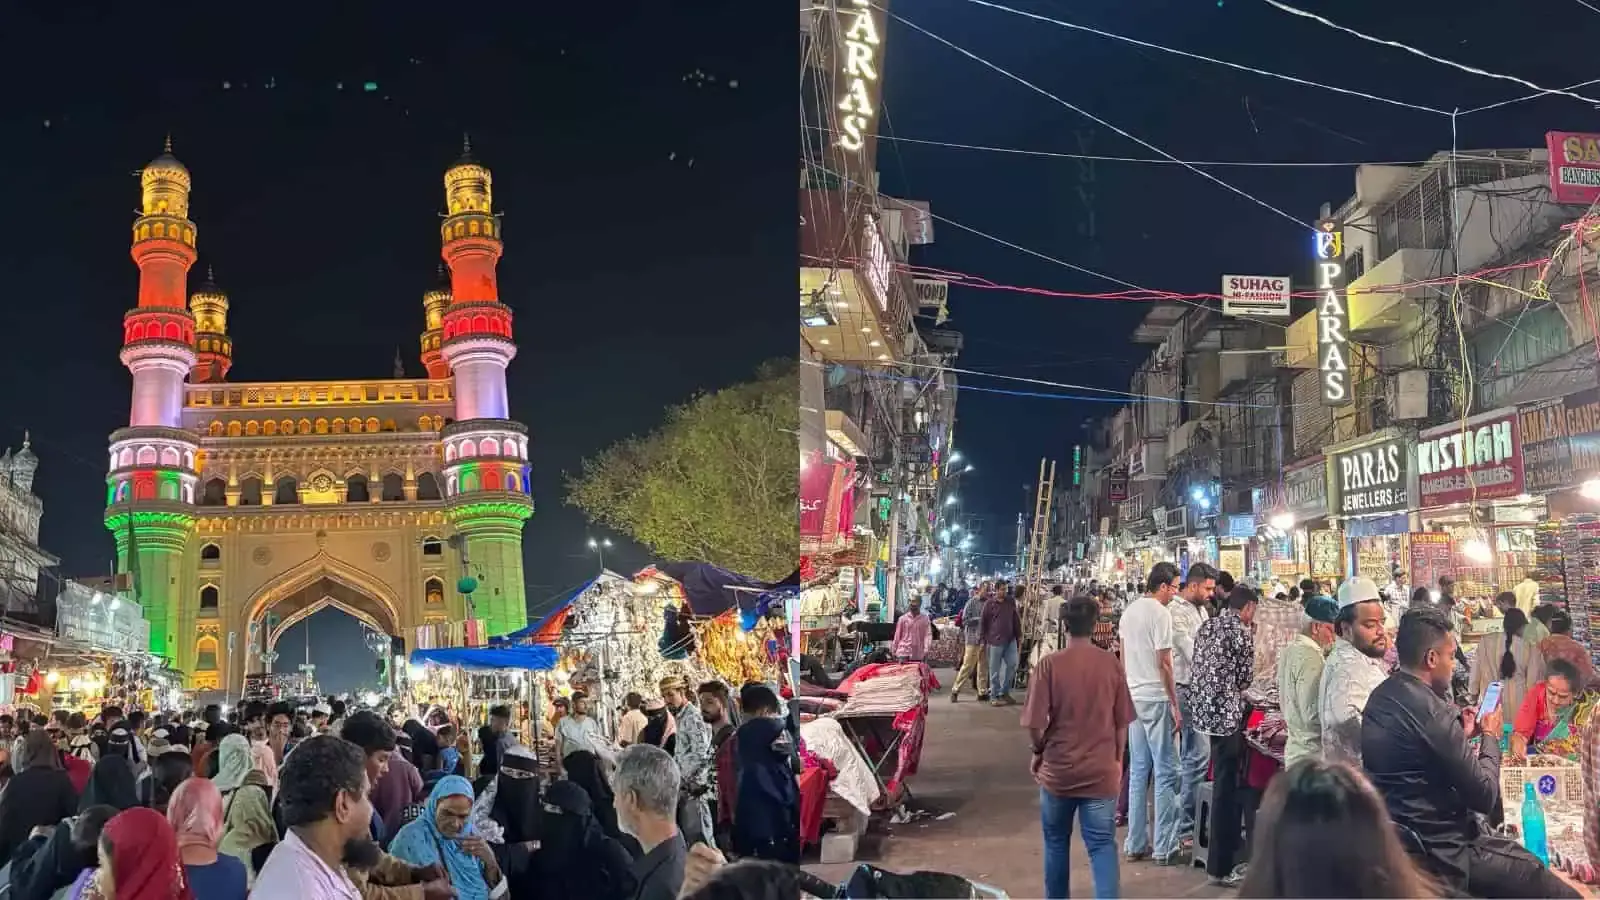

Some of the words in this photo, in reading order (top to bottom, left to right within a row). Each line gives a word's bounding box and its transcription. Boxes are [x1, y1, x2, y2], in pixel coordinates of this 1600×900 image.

[838, 0, 880, 150] ARAS
[1230, 278, 1284, 291] SUHAG
[1319, 263, 1347, 400] PARAS
[1341, 444, 1400, 491] PARAS
[1342, 487, 1393, 512] JEWELLERS
